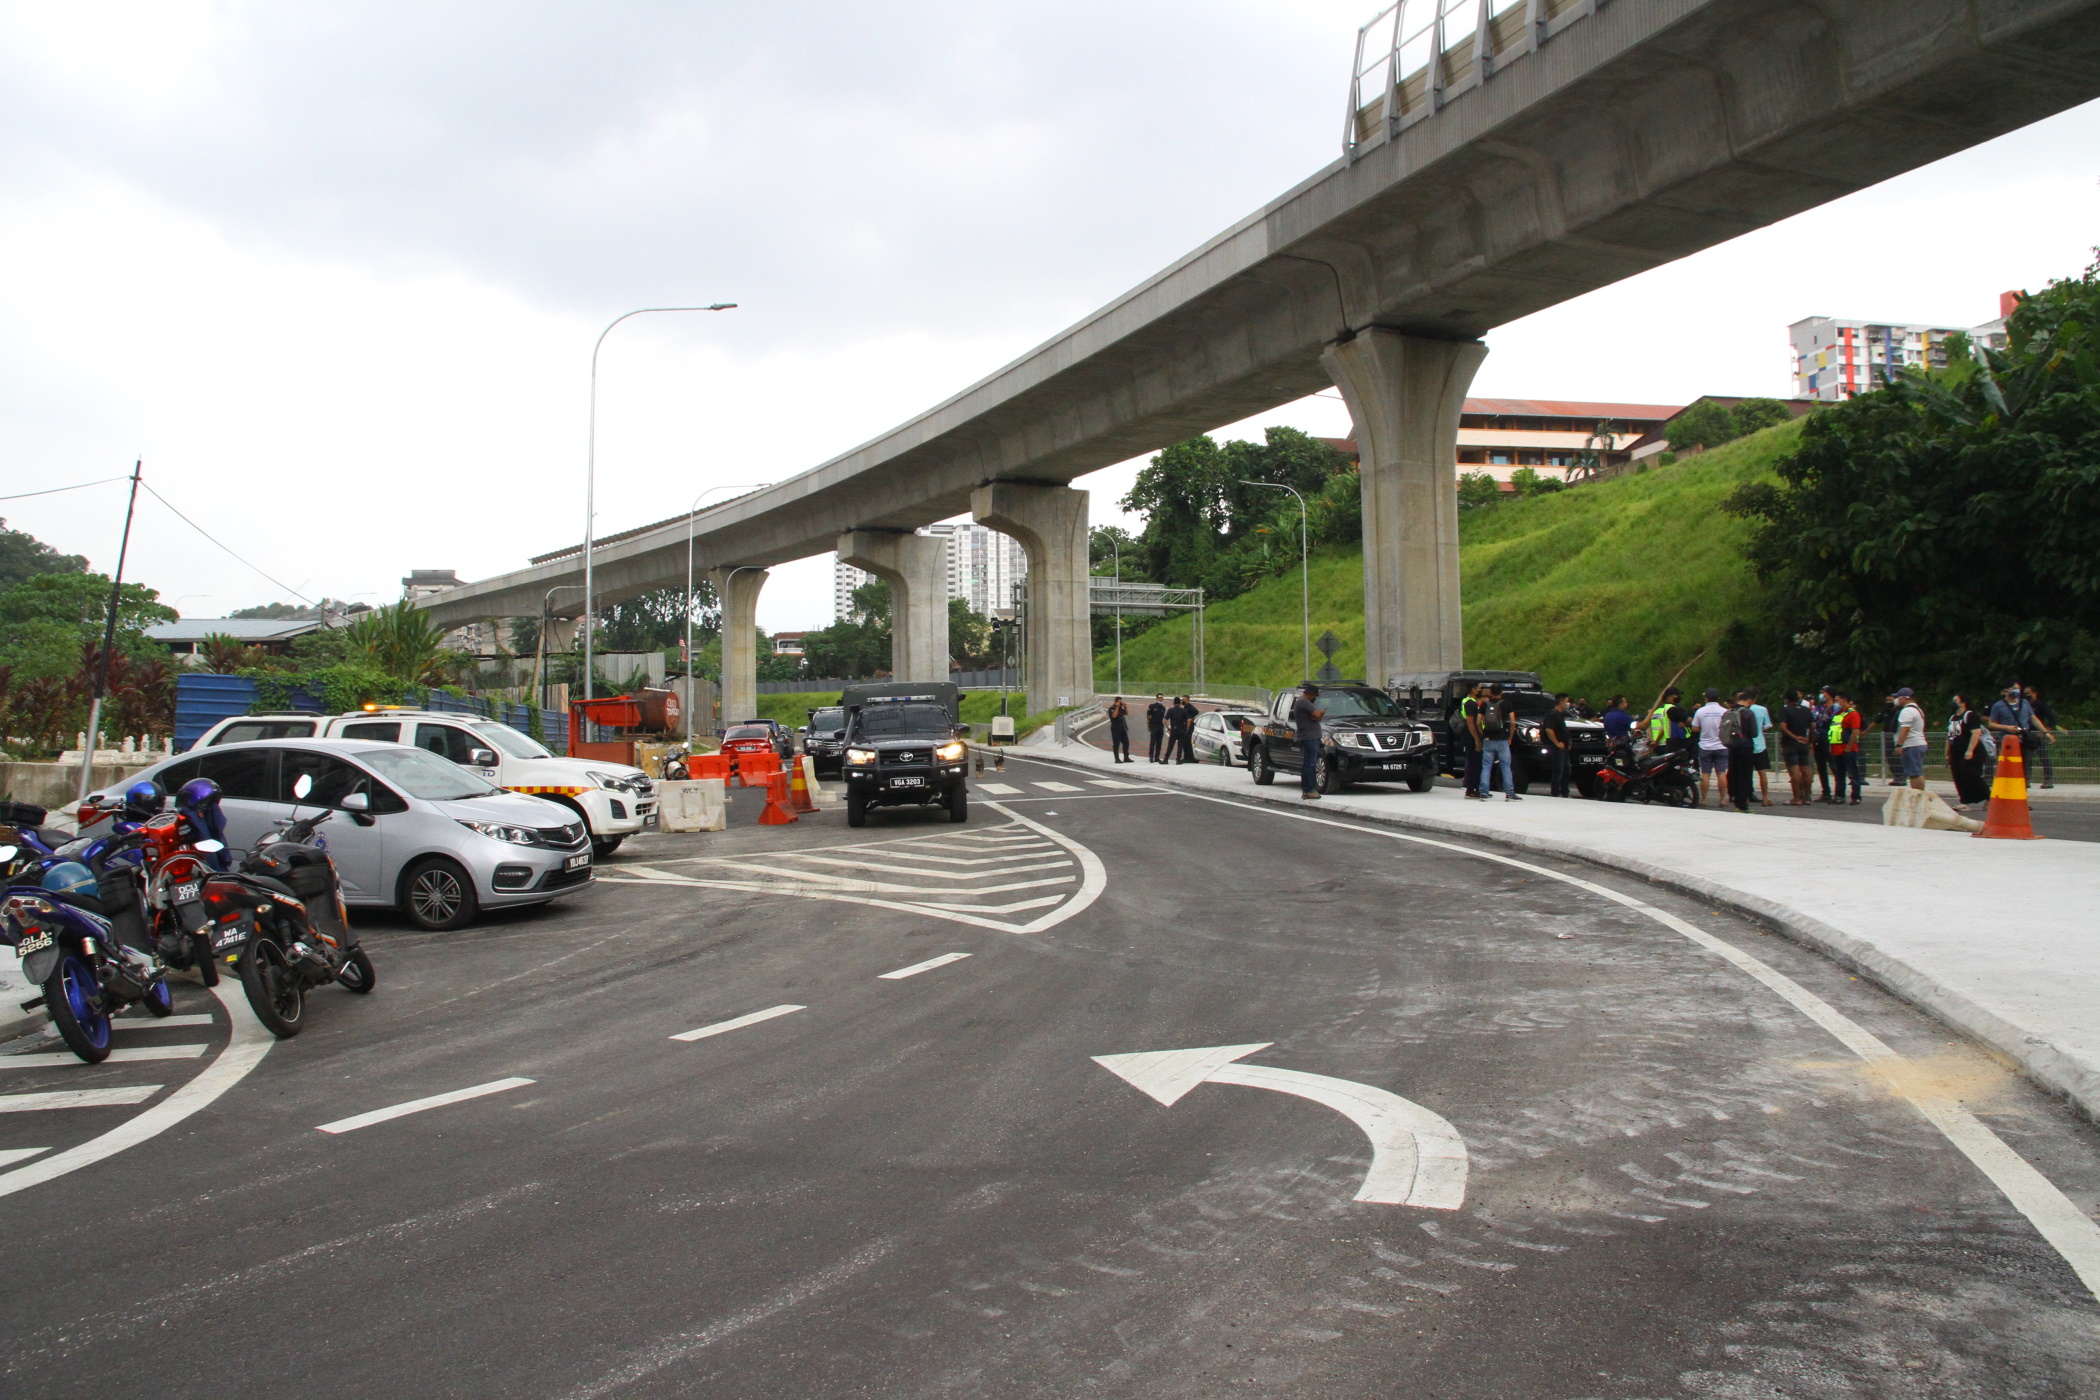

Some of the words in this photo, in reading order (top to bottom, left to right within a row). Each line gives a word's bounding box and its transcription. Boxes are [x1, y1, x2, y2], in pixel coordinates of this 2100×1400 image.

[905, 778, 921, 786] 3203
[178, 890, 196, 901] 477
[223, 927, 238, 938] WA
[18, 938, 53, 956] 5256
